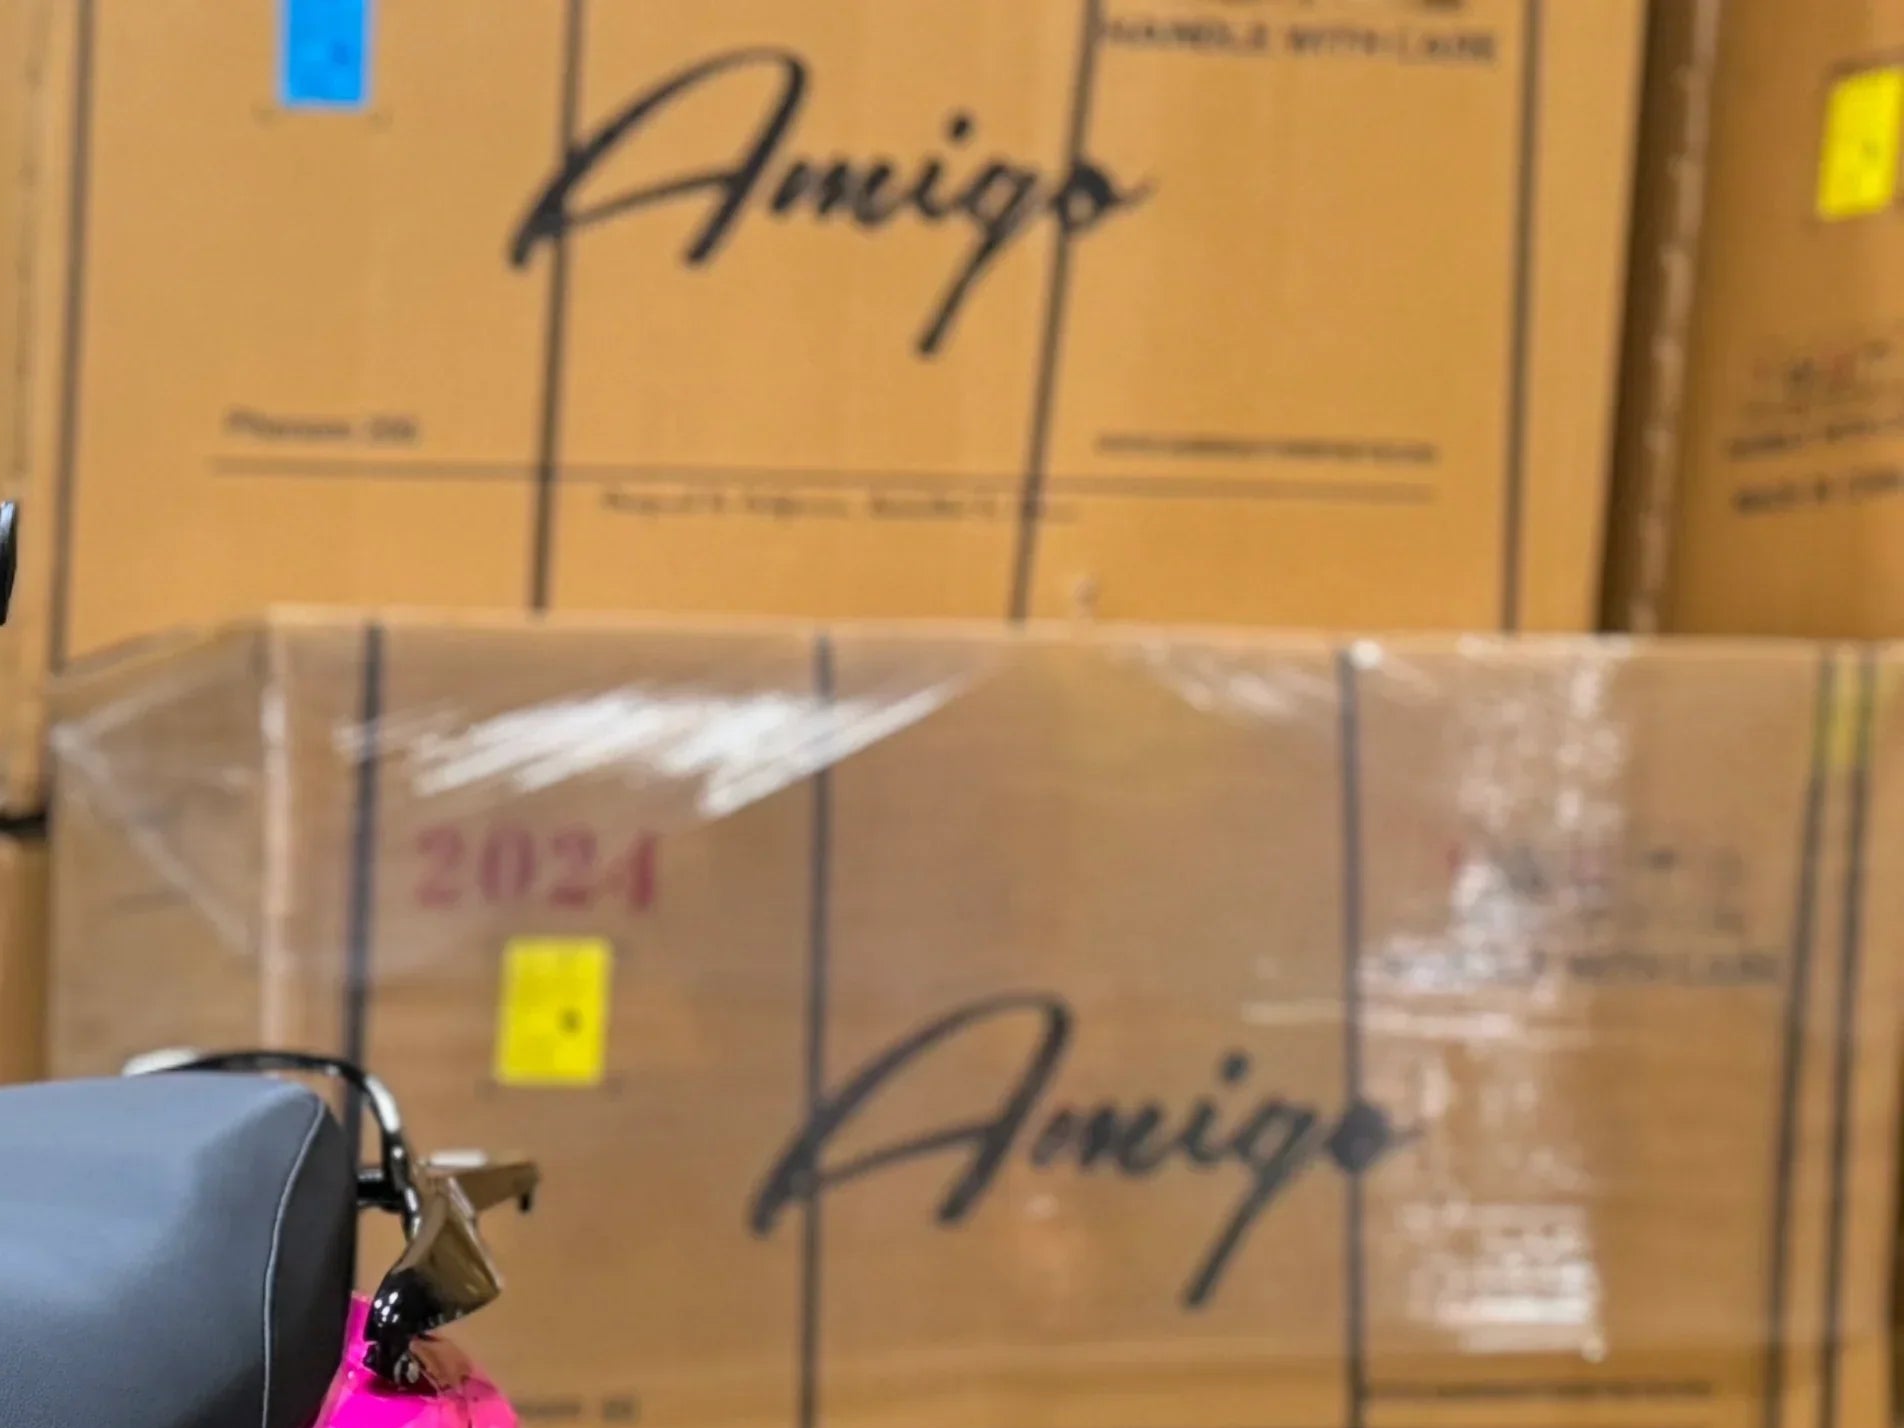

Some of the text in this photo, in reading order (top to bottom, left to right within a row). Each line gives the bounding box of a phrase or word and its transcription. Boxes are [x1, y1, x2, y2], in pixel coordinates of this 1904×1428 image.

[505, 46, 1157, 359] Amigo
[414, 823, 657, 915] 2024
[748, 994, 1424, 1312] Amigo
